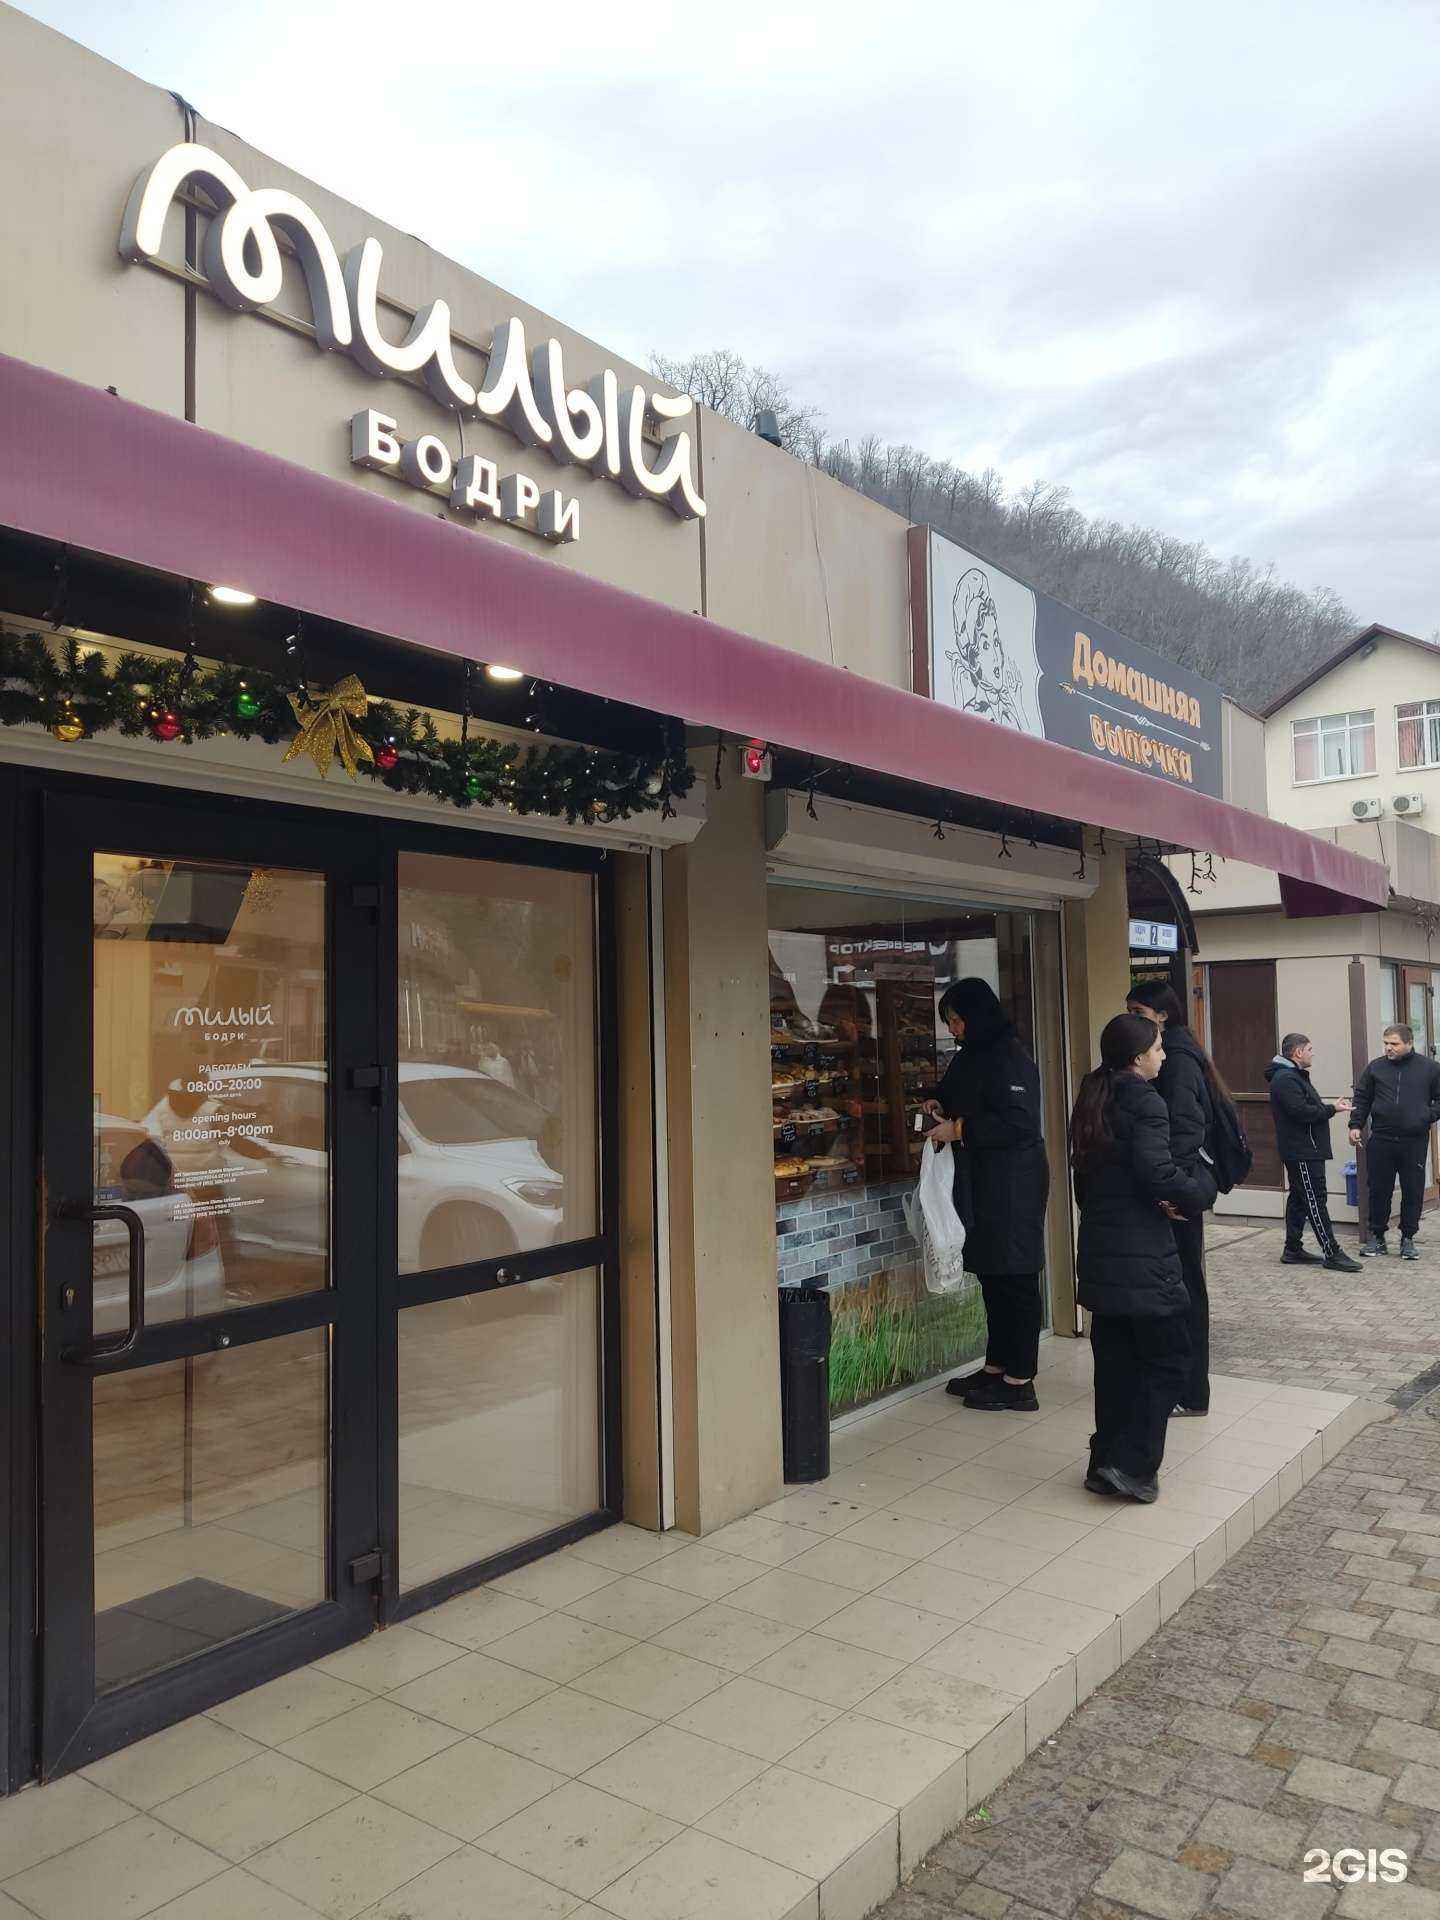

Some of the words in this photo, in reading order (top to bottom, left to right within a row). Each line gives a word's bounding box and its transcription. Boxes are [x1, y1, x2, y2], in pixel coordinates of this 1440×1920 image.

[353, 408, 580, 543] БОДРИ
[1072, 631, 1201, 728] Домашняя
[204, 1032, 245, 1042] БОДРИ
[192, 1112, 230, 1125] opening
[231, 1111, 257, 1120] hours
